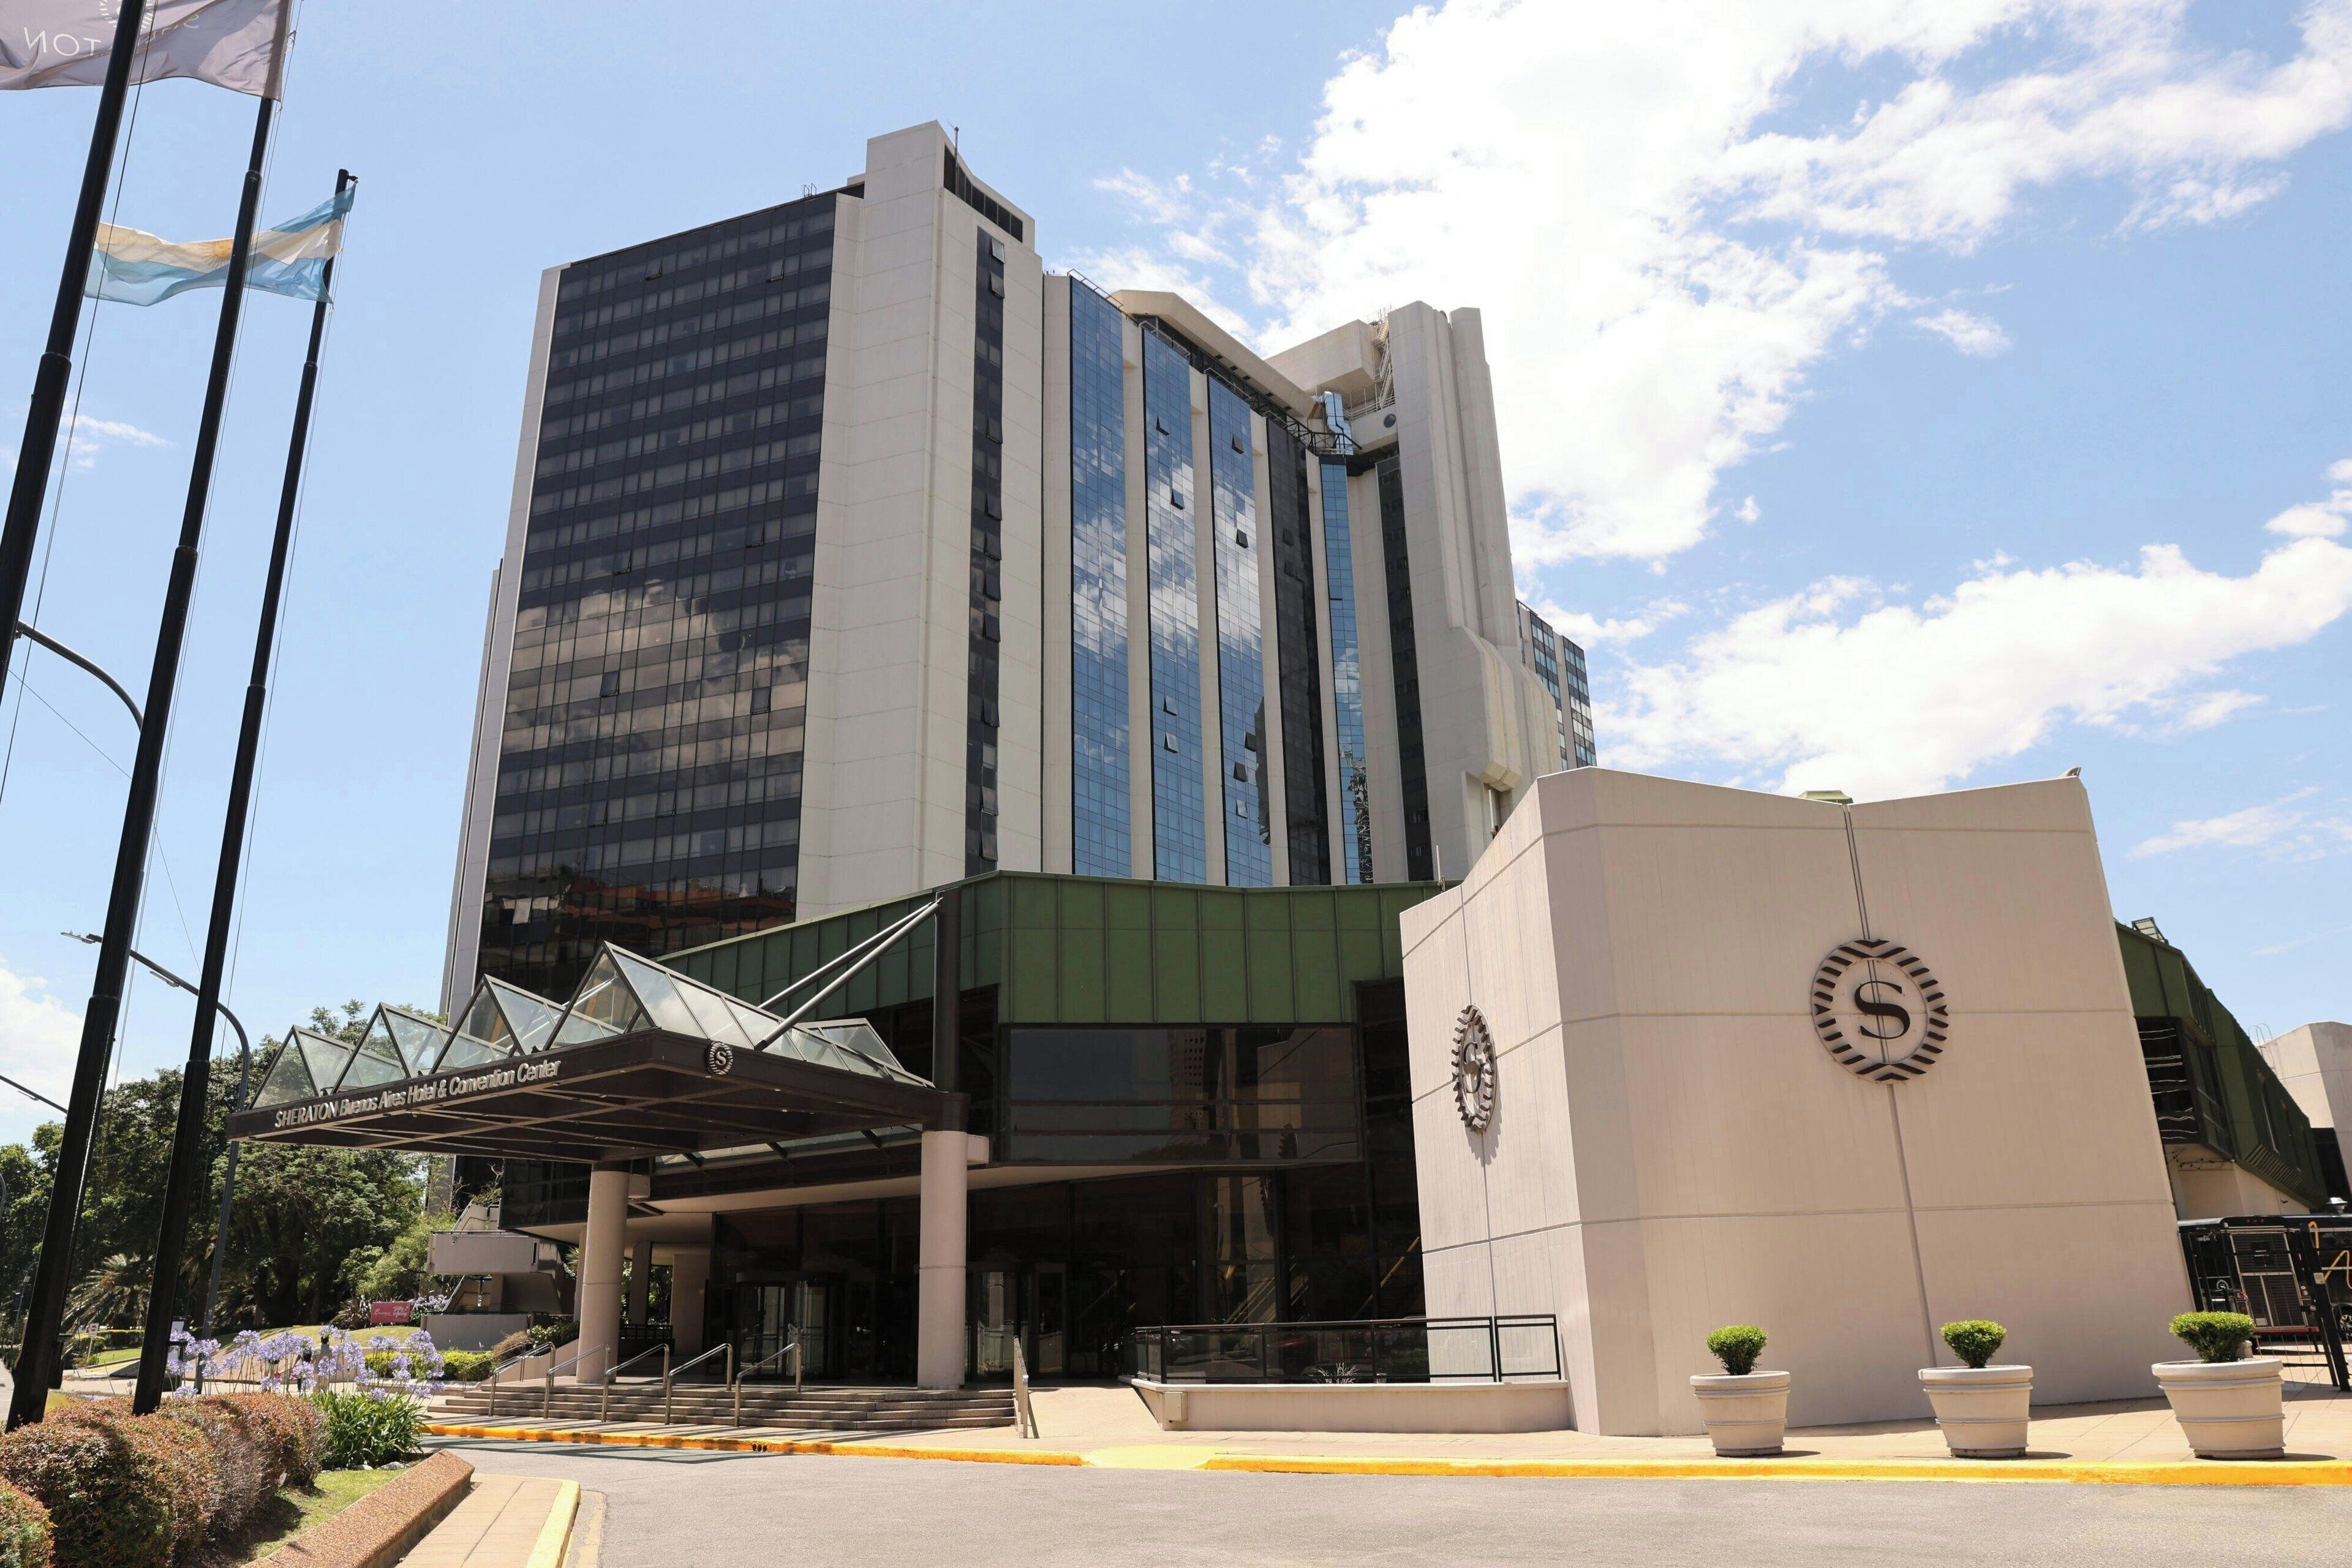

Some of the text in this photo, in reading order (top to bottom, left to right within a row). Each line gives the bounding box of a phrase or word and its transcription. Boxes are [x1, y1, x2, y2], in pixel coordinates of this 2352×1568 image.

[1853, 981, 1911, 1040] S
[715, 1051, 727, 1066] S
[275, 1060, 561, 1128] SHERATON Buenos Aires Hotel & Convention Center
